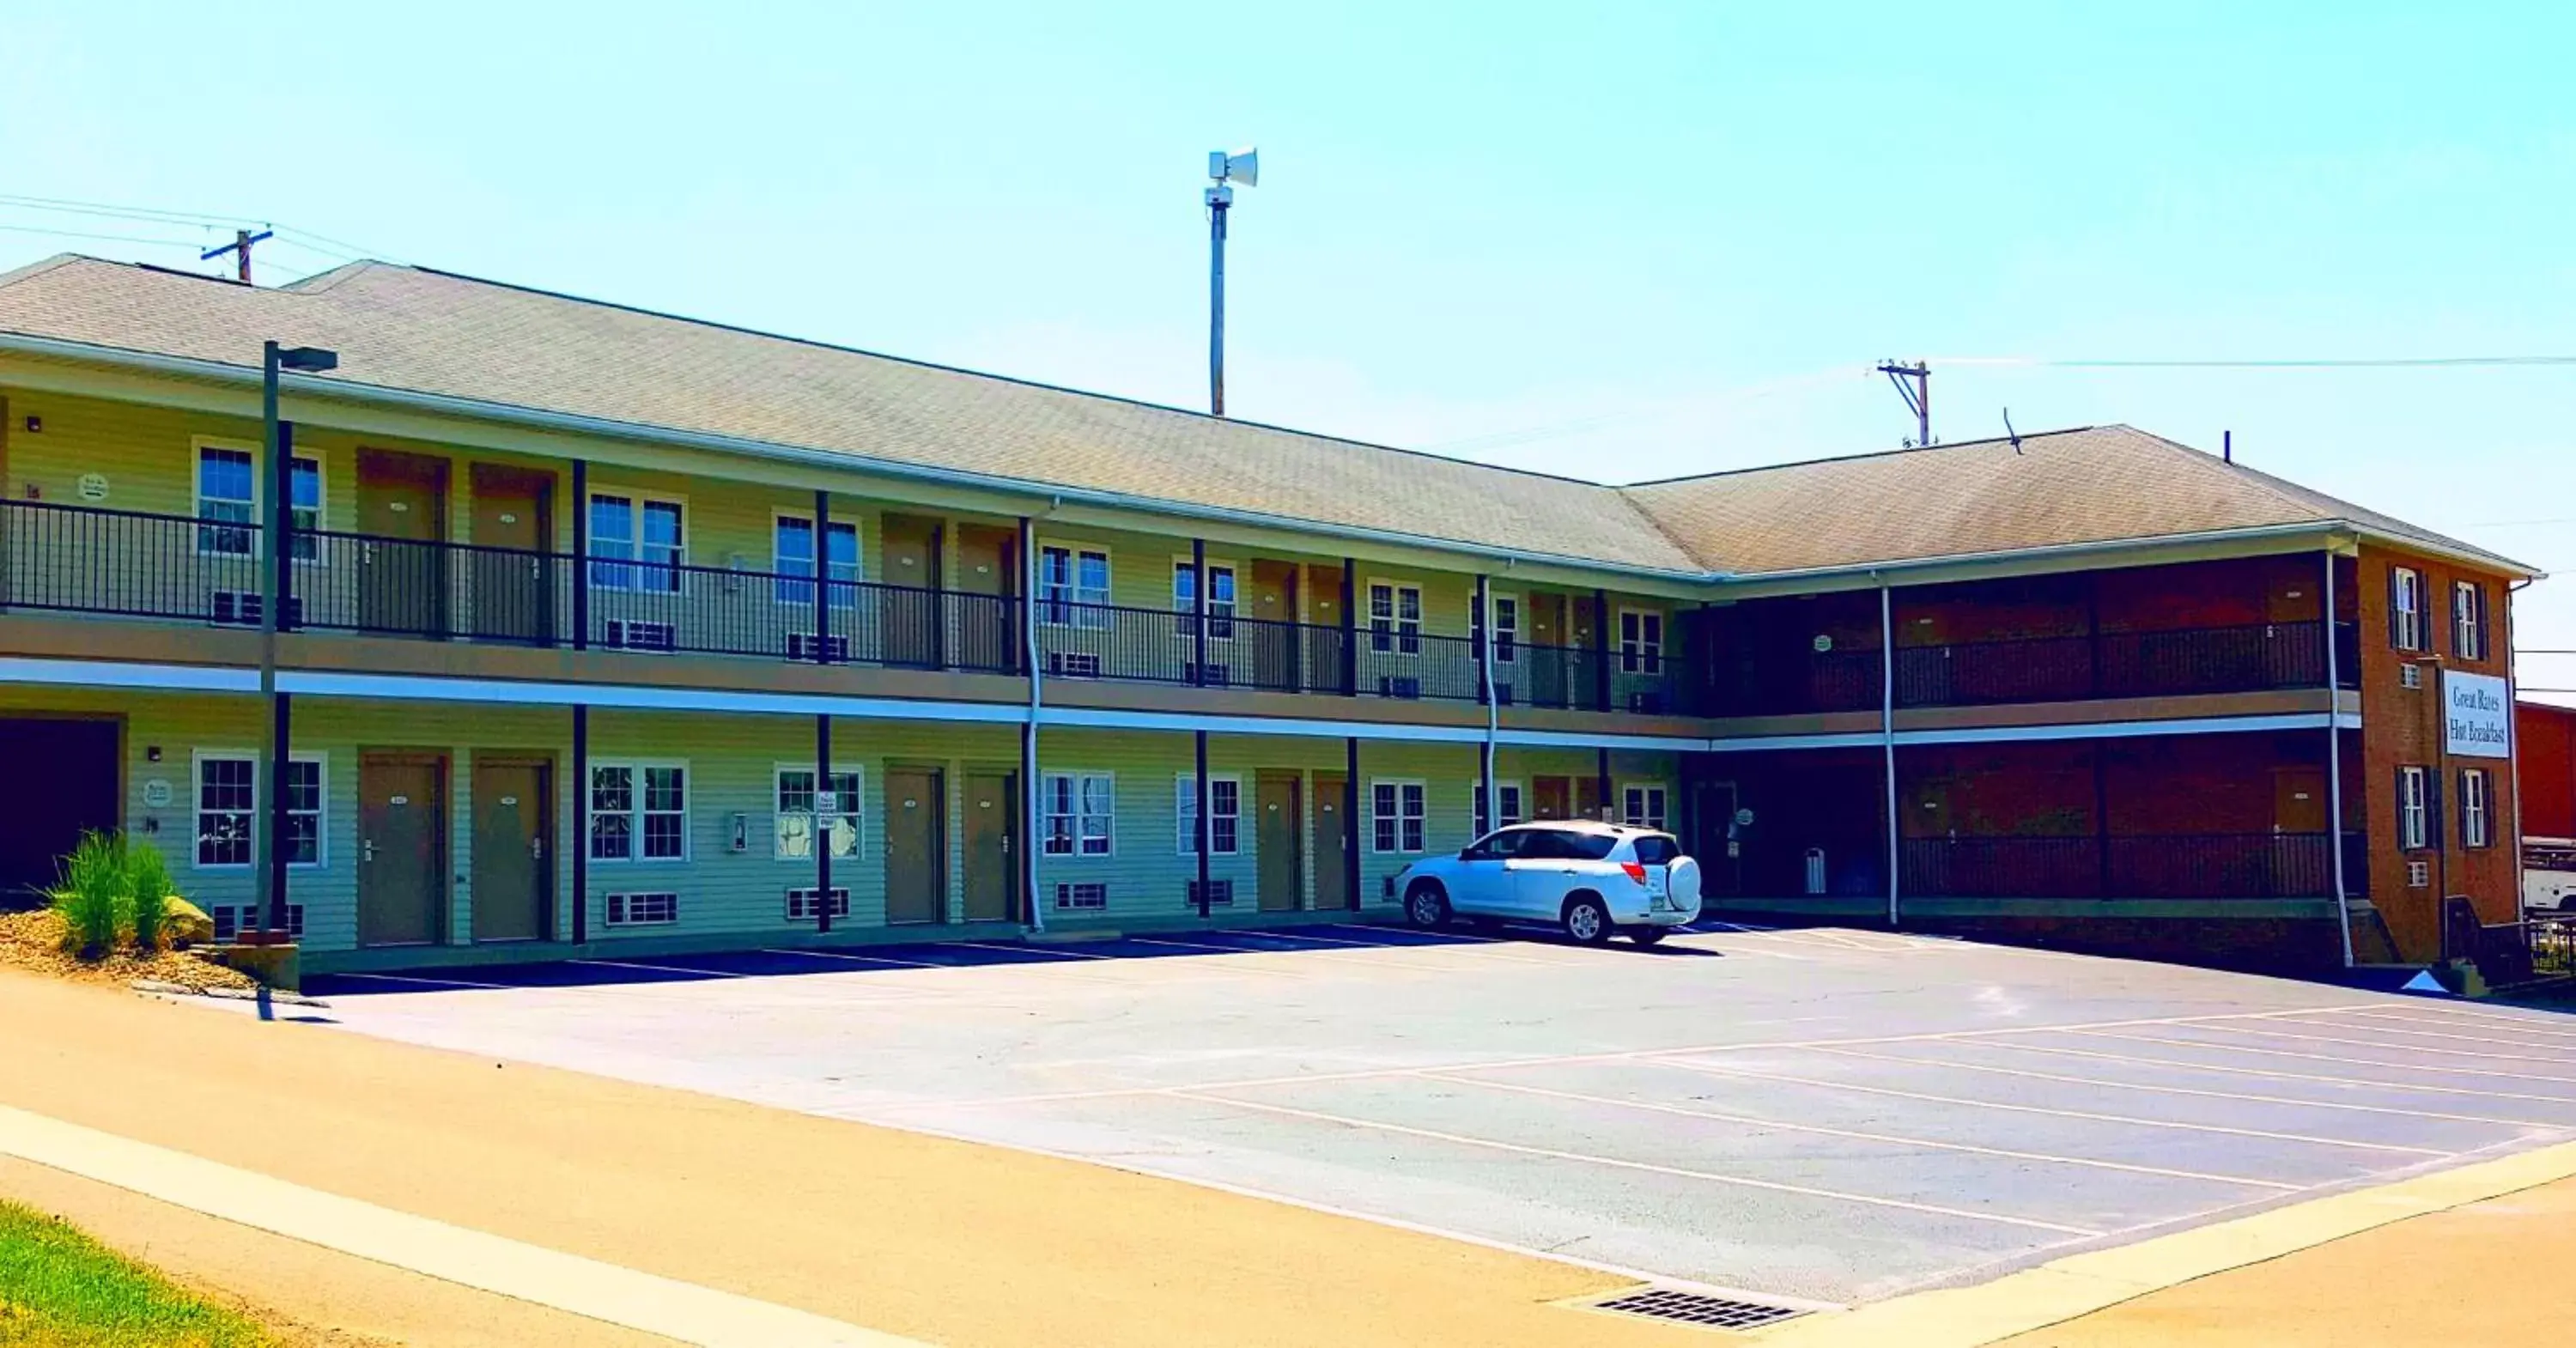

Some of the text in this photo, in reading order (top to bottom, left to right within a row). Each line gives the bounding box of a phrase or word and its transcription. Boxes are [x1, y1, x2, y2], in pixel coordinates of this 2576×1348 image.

[2453, 686, 2500, 712] Great Rates
[2450, 718, 2505, 744] Hot Breakfast
